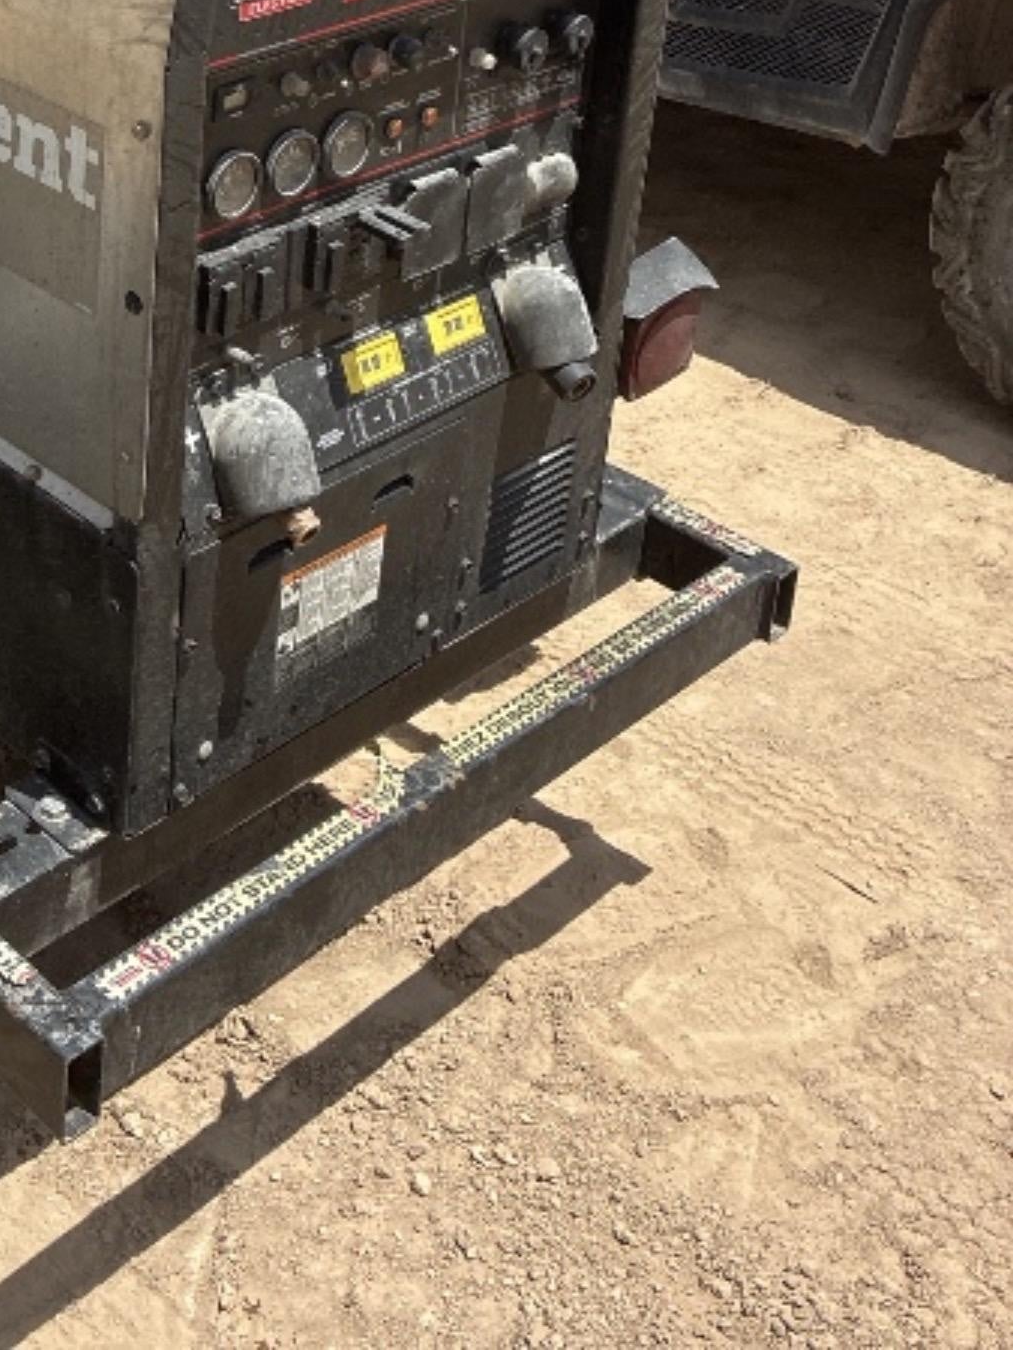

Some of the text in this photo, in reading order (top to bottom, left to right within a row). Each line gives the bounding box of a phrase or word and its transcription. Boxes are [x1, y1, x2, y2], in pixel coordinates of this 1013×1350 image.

[165, 922, 202, 952] DO
[203, 895, 244, 929] NOT
[241, 850, 307, 899] STAD
